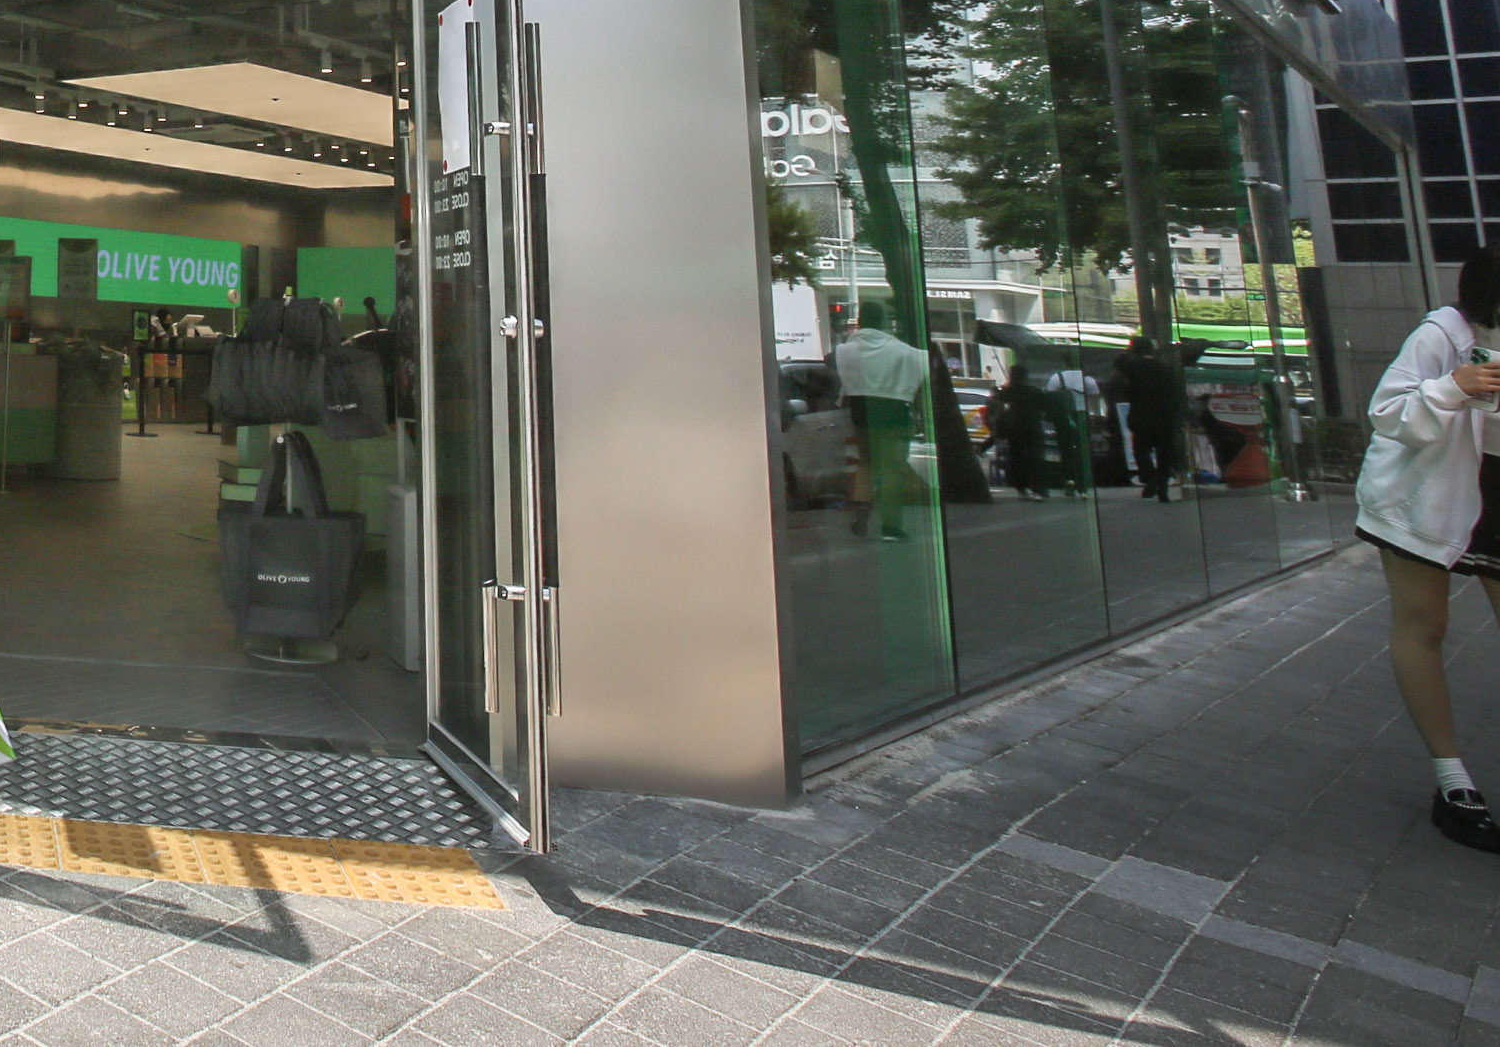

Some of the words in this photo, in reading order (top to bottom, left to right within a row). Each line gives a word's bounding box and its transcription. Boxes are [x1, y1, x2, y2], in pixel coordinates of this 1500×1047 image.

[97, 250, 161, 281] OLIVE
[168, 256, 239, 288] YOUNG
[257, 573, 277, 582] OLIVE
[287, 575, 310, 584] YOUNG
